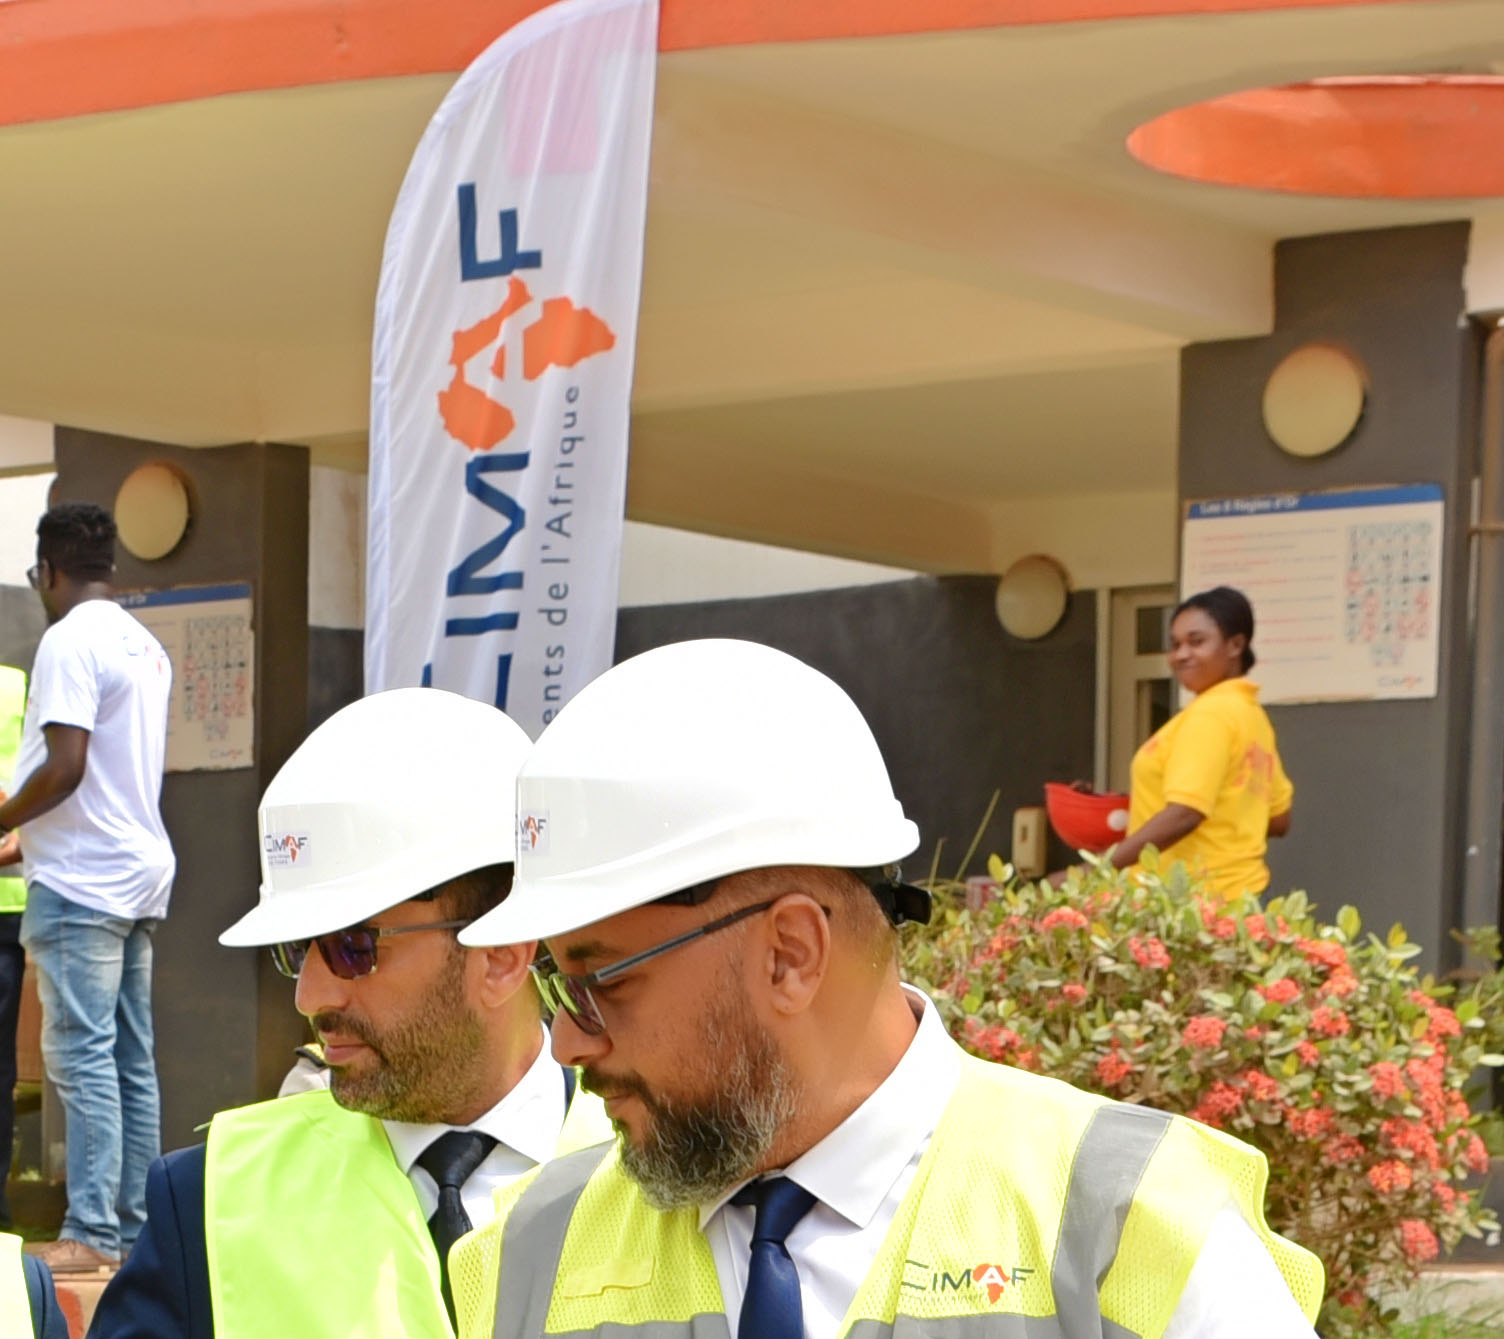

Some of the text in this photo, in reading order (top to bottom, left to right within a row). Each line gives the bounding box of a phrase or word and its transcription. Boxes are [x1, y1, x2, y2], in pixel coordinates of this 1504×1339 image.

[538, 386, 586, 725] ents de l'Afrique
